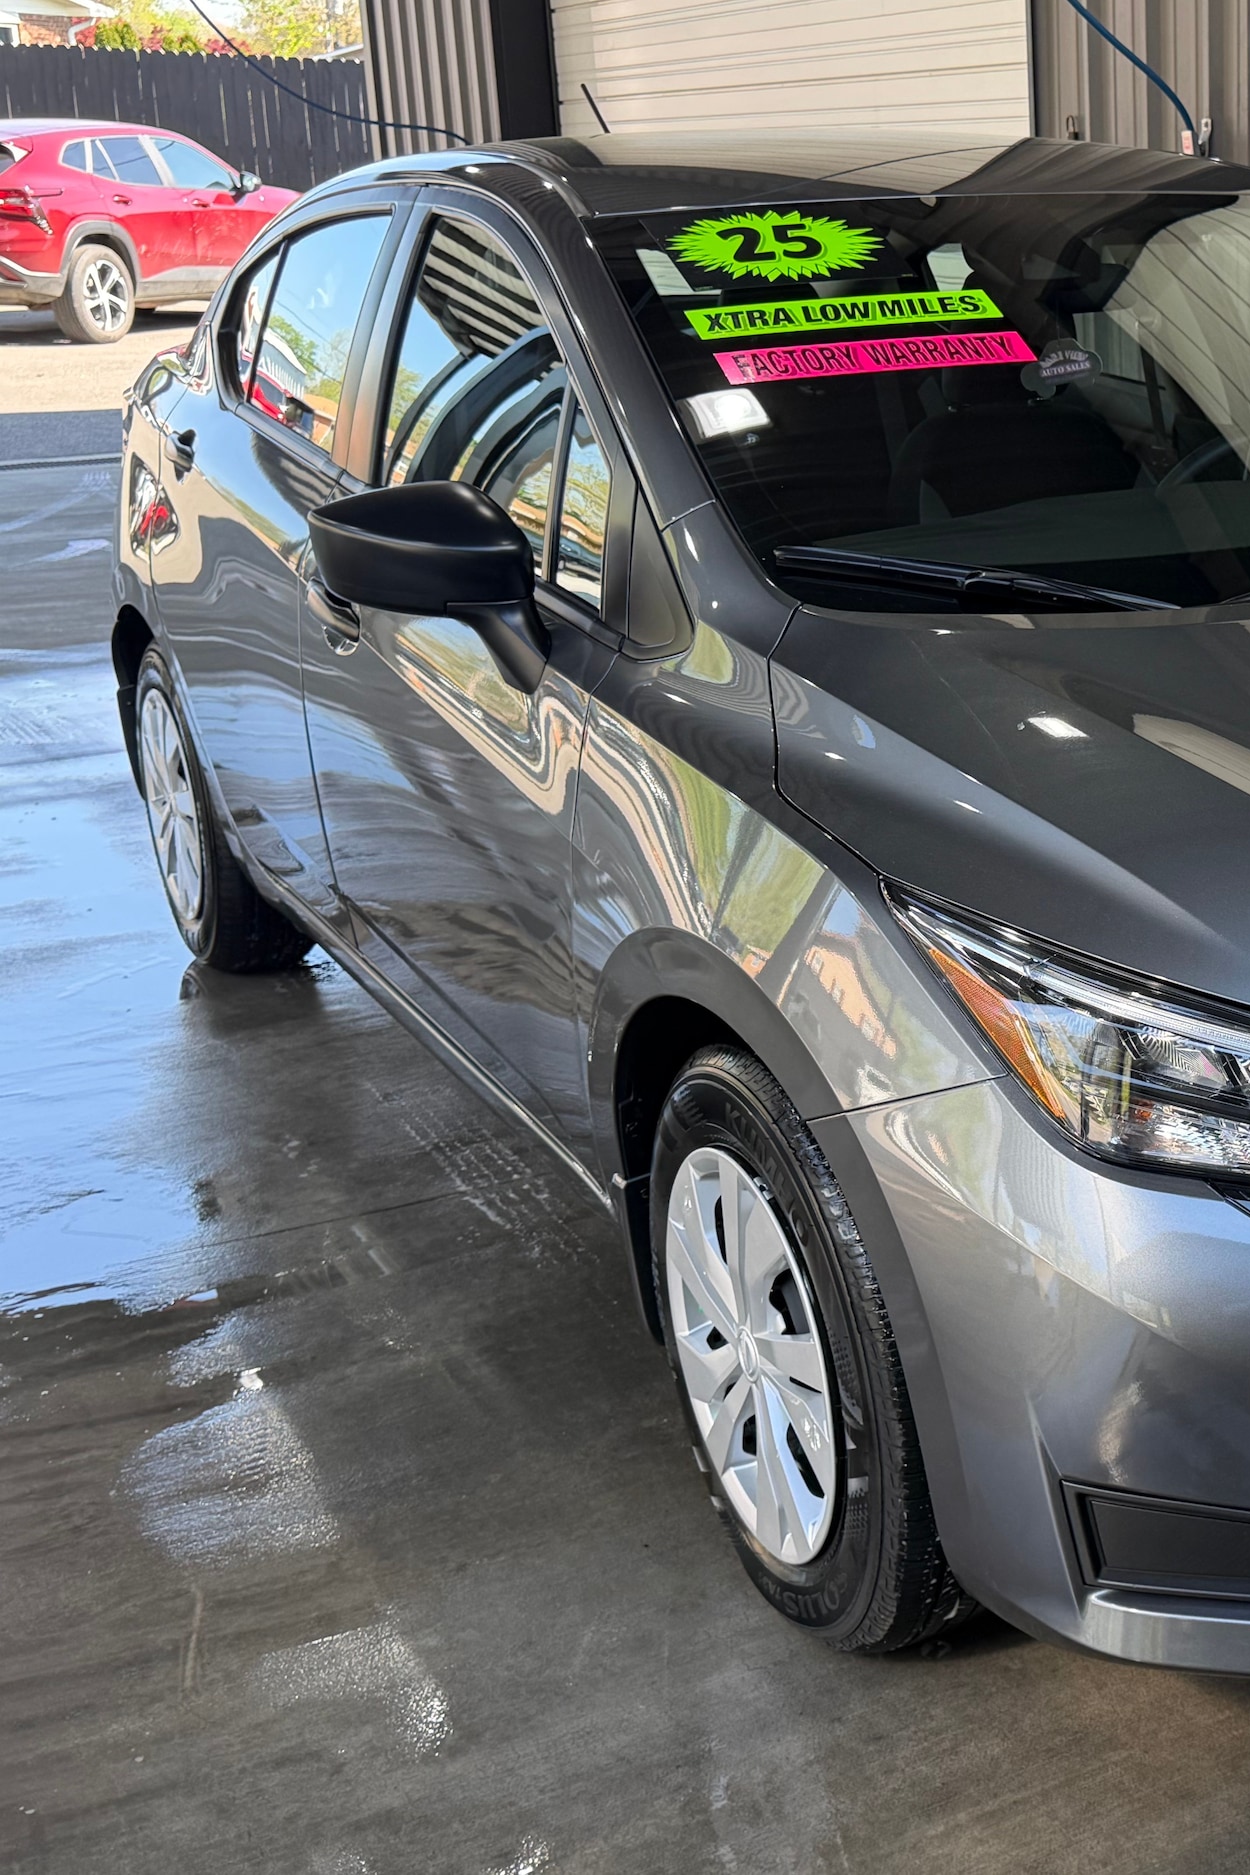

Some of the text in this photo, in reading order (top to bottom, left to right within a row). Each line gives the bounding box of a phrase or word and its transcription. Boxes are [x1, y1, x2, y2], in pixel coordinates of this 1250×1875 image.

[717, 223, 823, 263] 25
[703, 294, 983, 333] XTRA LOW MILES
[732, 335, 1013, 381] FACTORY WARRANTY
[1040, 361, 1091, 377] AUTO SALES
